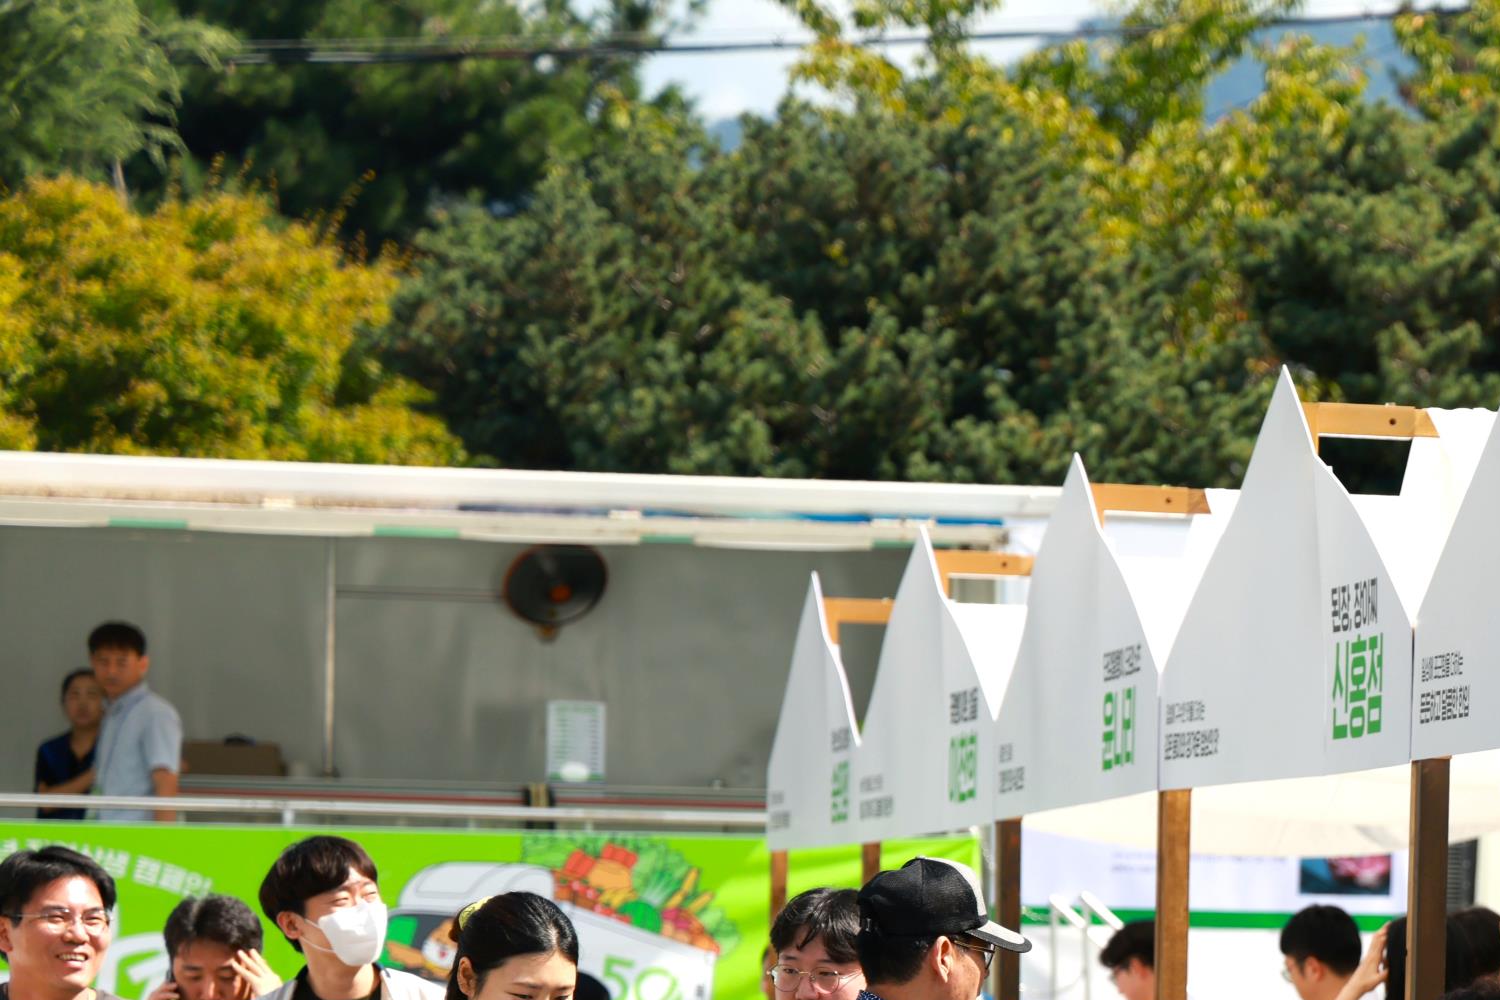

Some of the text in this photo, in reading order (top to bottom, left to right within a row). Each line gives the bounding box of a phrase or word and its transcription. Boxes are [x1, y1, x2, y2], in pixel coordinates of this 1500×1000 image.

[1331, 577, 1378, 633] 된장, 장아찌
[1331, 632, 1384, 740] 신홍점
